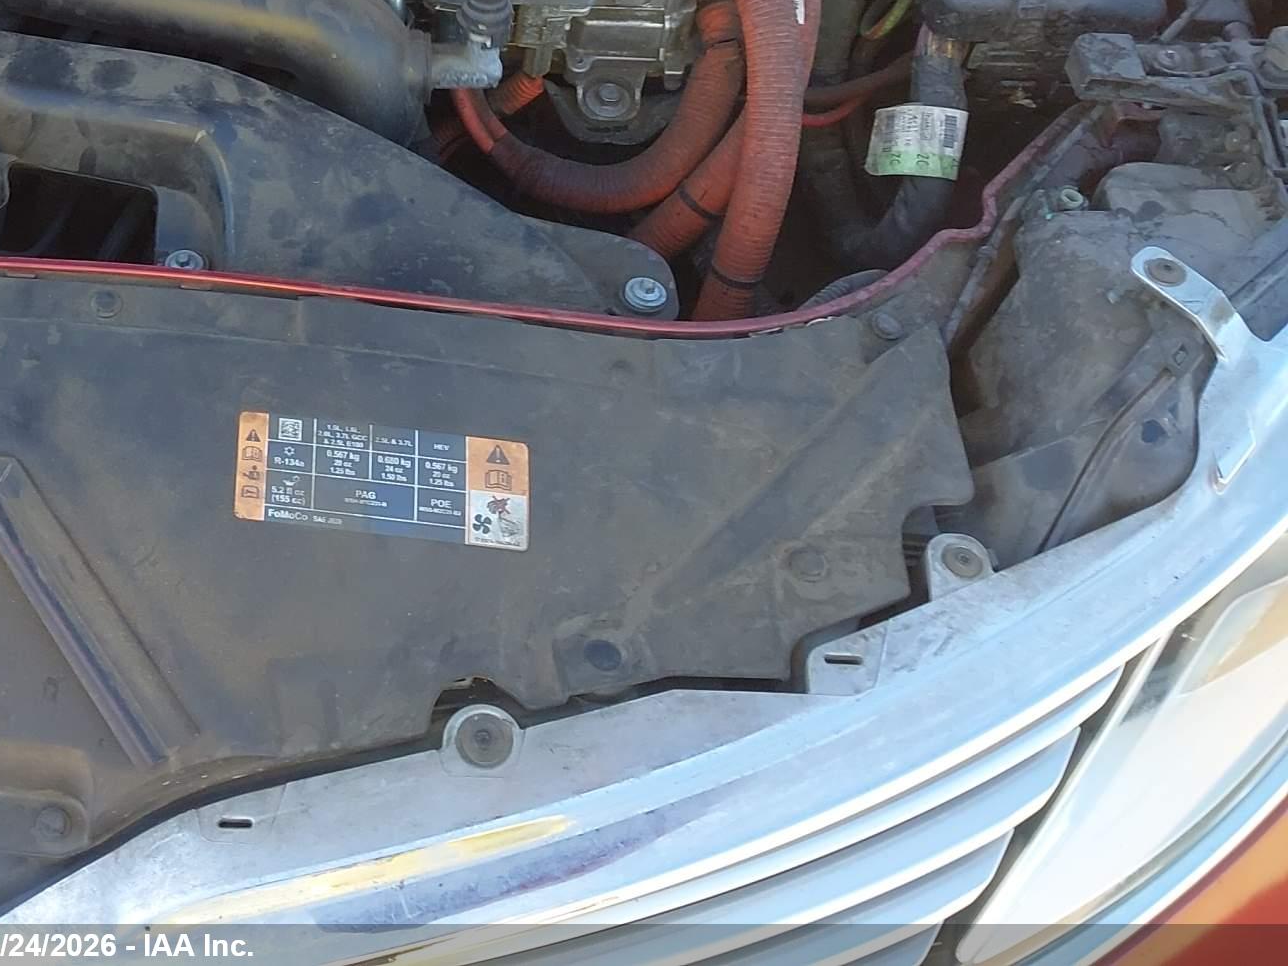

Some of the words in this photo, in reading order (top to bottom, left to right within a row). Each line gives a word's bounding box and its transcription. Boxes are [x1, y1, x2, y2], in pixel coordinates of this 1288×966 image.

[326, 449, 348, 460] 0.567
[349, 452, 360, 462] kg
[273, 457, 305, 468] R-134a
[400, 458, 412, 468] kg
[424, 461, 446, 471] 0.567
[447, 464, 458, 474] kg
[329, 467, 344, 475] 1.25
[384, 465, 394, 473] 24
[271, 485, 284, 494] 5.2
[355, 489, 377, 500] PAG
[271, 494, 290, 503] (155
[430, 498, 452, 509] POE
[268, 509, 309, 521] FoMoCo
